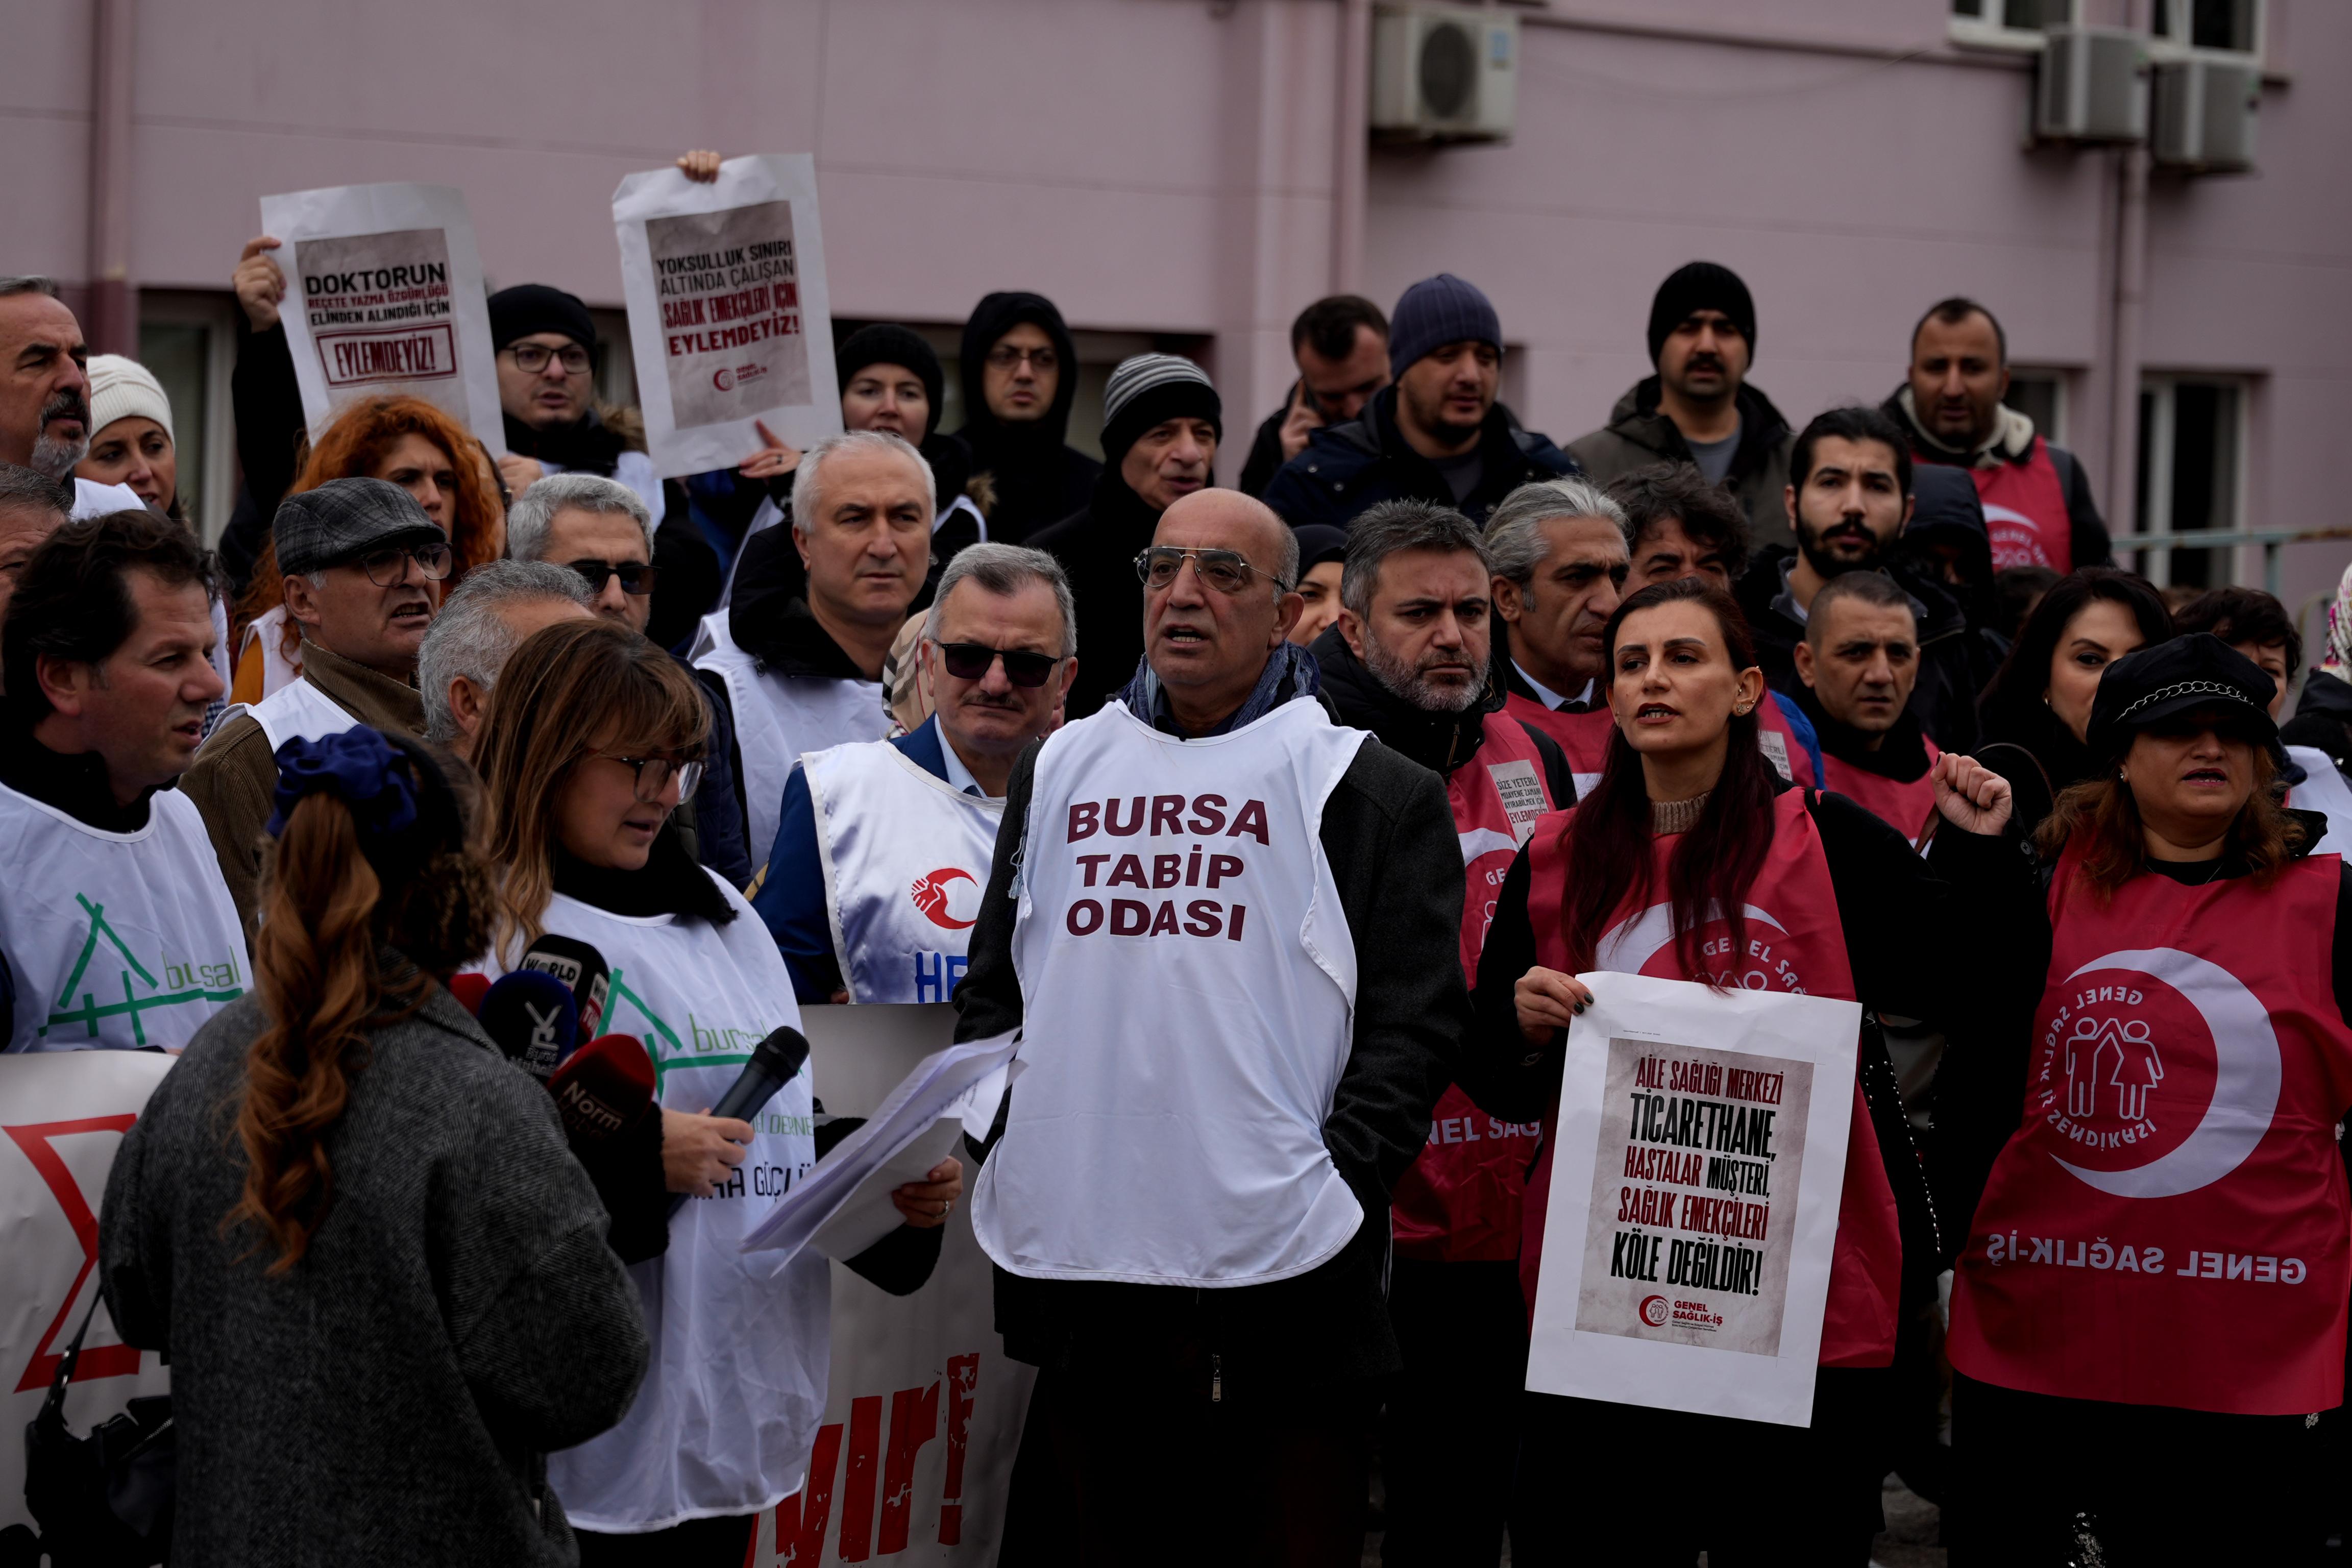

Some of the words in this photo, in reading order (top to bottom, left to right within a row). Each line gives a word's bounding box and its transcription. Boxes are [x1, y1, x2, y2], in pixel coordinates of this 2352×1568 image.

[656, 247, 746, 275] YOKSULLUK
[749, 240, 792, 262] SINIRI
[305, 262, 447, 296] DOKTORUN
[661, 271, 726, 296] ALTINDA
[730, 258, 794, 290] ÇALIŞAN
[308, 297, 347, 310] REÇETE
[351, 294, 385, 307] YAZMA
[388, 284, 449, 302] ÖZGÜRLÜĞÜ
[311, 308, 364, 326] ELİNDEN
[368, 302, 421, 322] ALINDIĞI
[425, 299, 450, 320] İÇİN
[664, 298, 706, 329] SAĞLIK
[668, 311, 800, 357] EYLEMDEYİZ!
[334, 333, 436, 378] EYLEMDEYİZ!
[1496, 779, 1512, 791] SİZE
[1512, 774, 1538, 788] YETERLİ
[1501, 790, 1524, 800] MUAYENE
[1524, 788, 1542, 797] ZAMANI
[1067, 794, 1270, 846] BURSA
[1504, 797, 1536, 809] AYIRABİLMEK
[1535, 796, 1545, 807] İÇİN
[1076, 844, 1244, 890] TABİP
[1066, 898, 1246, 942] ODASI
[1702, 937, 1771, 963] GEEL
[1635, 1054, 1666, 1089] AİLE
[1670, 1059, 1723, 1096] SAĞLIĞI
[1725, 1068, 1784, 1105] MERKEZİ
[562, 1080, 623, 1132] Norm
[770, 1114, 815, 1136] DERNE
[1630, 1088, 1777, 1162] TİCARETHANE,
[1624, 1145, 1703, 1187] HASTALAR
[1706, 1155, 1771, 1198] MÜŞTERİ,
[1618, 1185, 1678, 1229] SAĞLIK
[1680, 1194, 1770, 1241] EMEKÇİLERİ
[1610, 1228, 1663, 1283] KÖLE
[1666, 1236, 1763, 1296] DEĞİLDİR!
[1672, 1310, 1723, 1326] SAĞLIK-İŞ
[1674, 1301, 1708, 1312] GENEL
